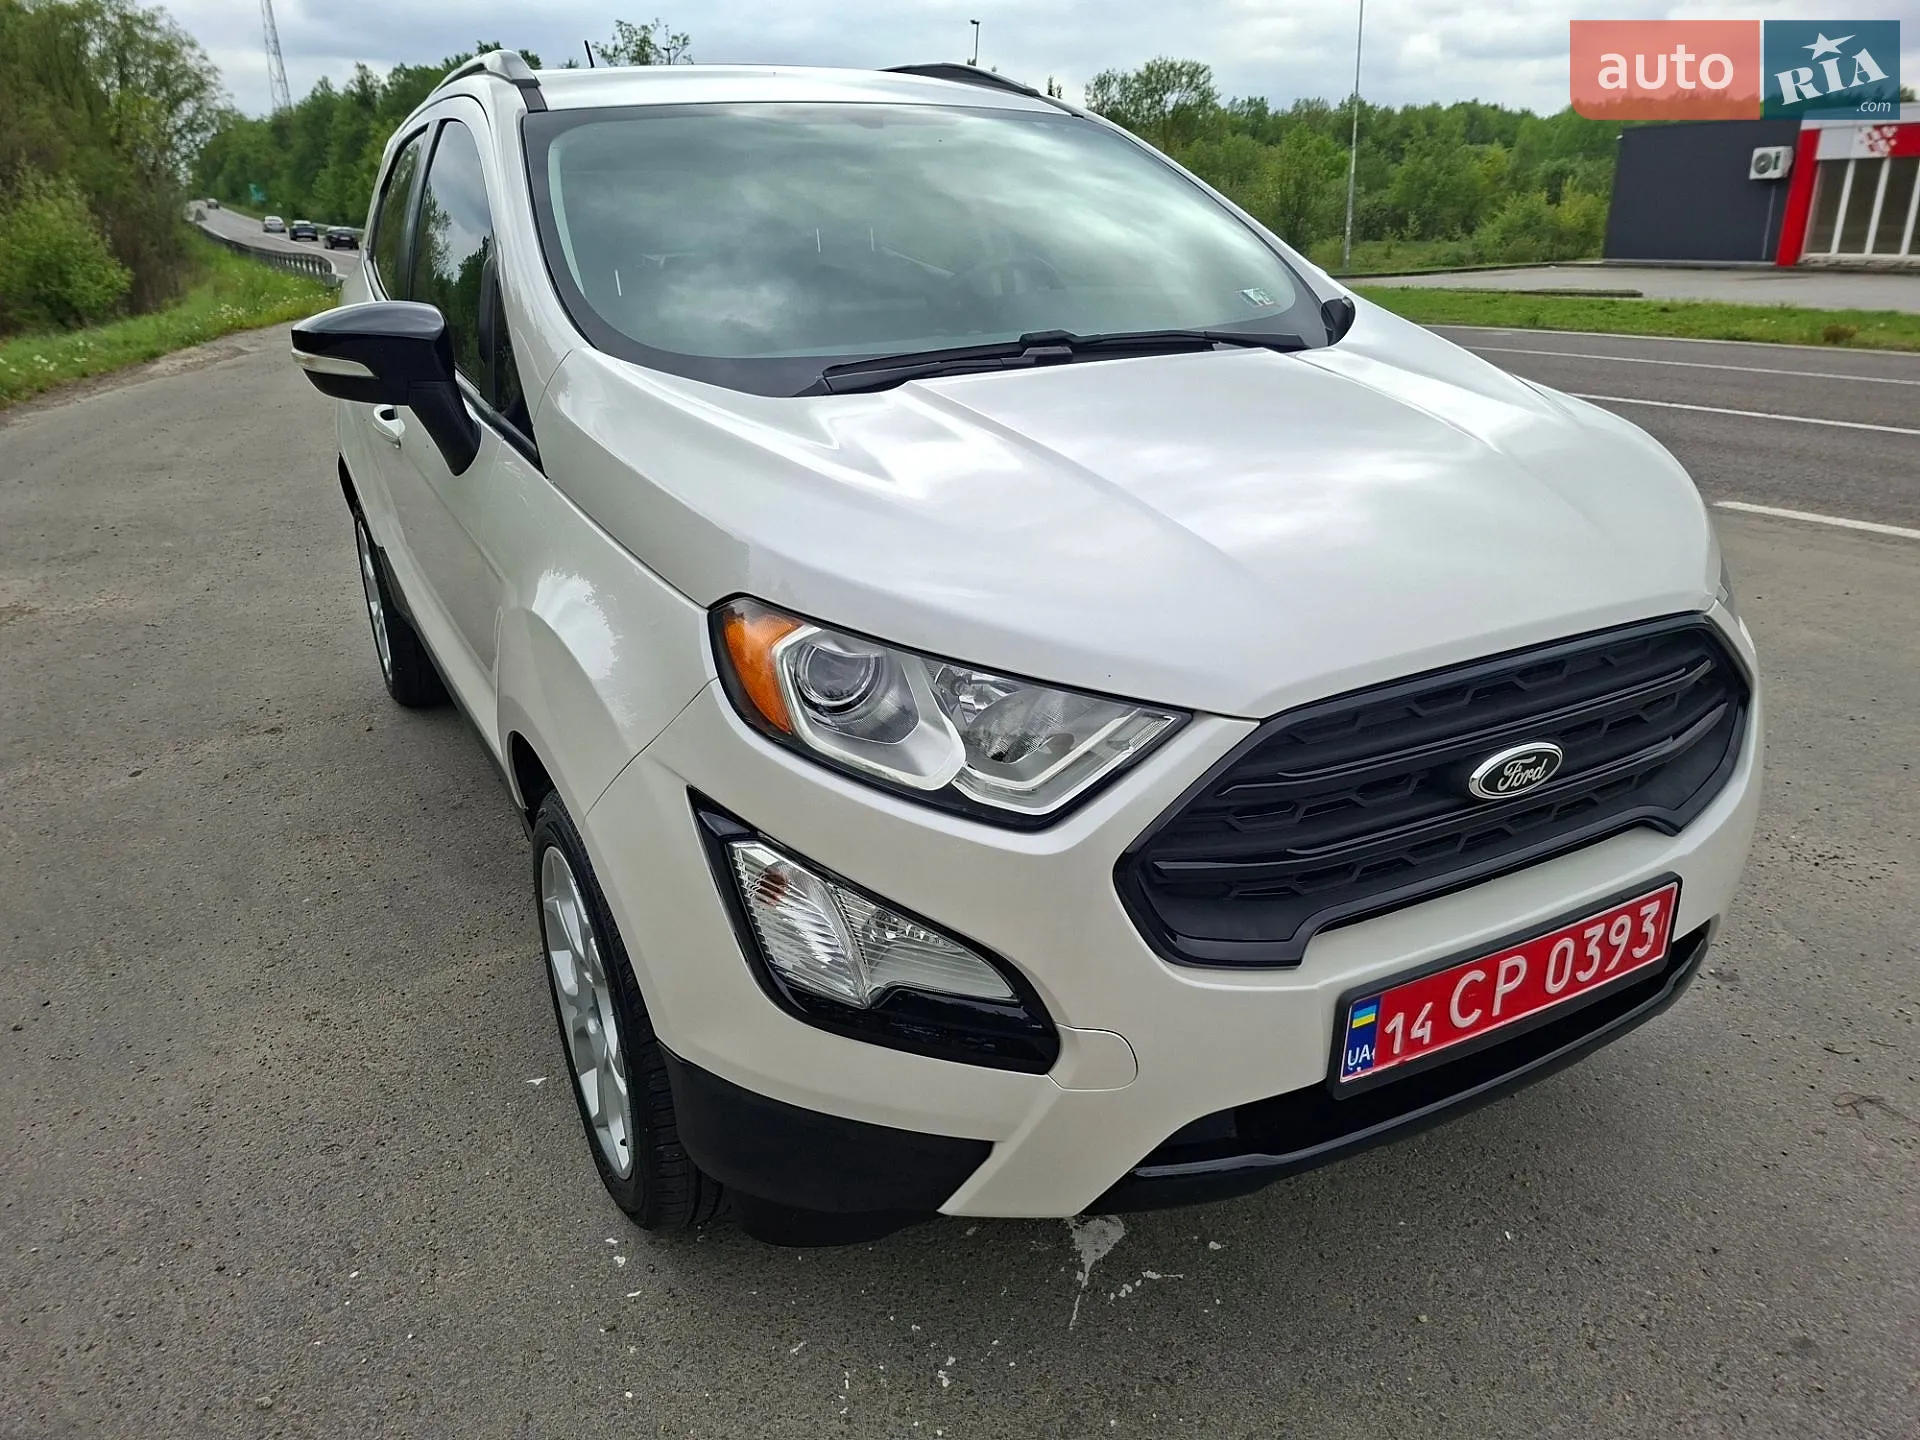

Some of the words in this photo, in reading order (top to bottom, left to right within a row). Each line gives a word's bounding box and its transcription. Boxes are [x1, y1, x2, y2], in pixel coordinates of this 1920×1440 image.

[1497, 755, 1548, 791] Ford
[1384, 1001, 1433, 1055] 14
[1449, 955, 1527, 1029] CP
[1545, 899, 1661, 995] 0393
[1346, 1044, 1371, 1067] UA
